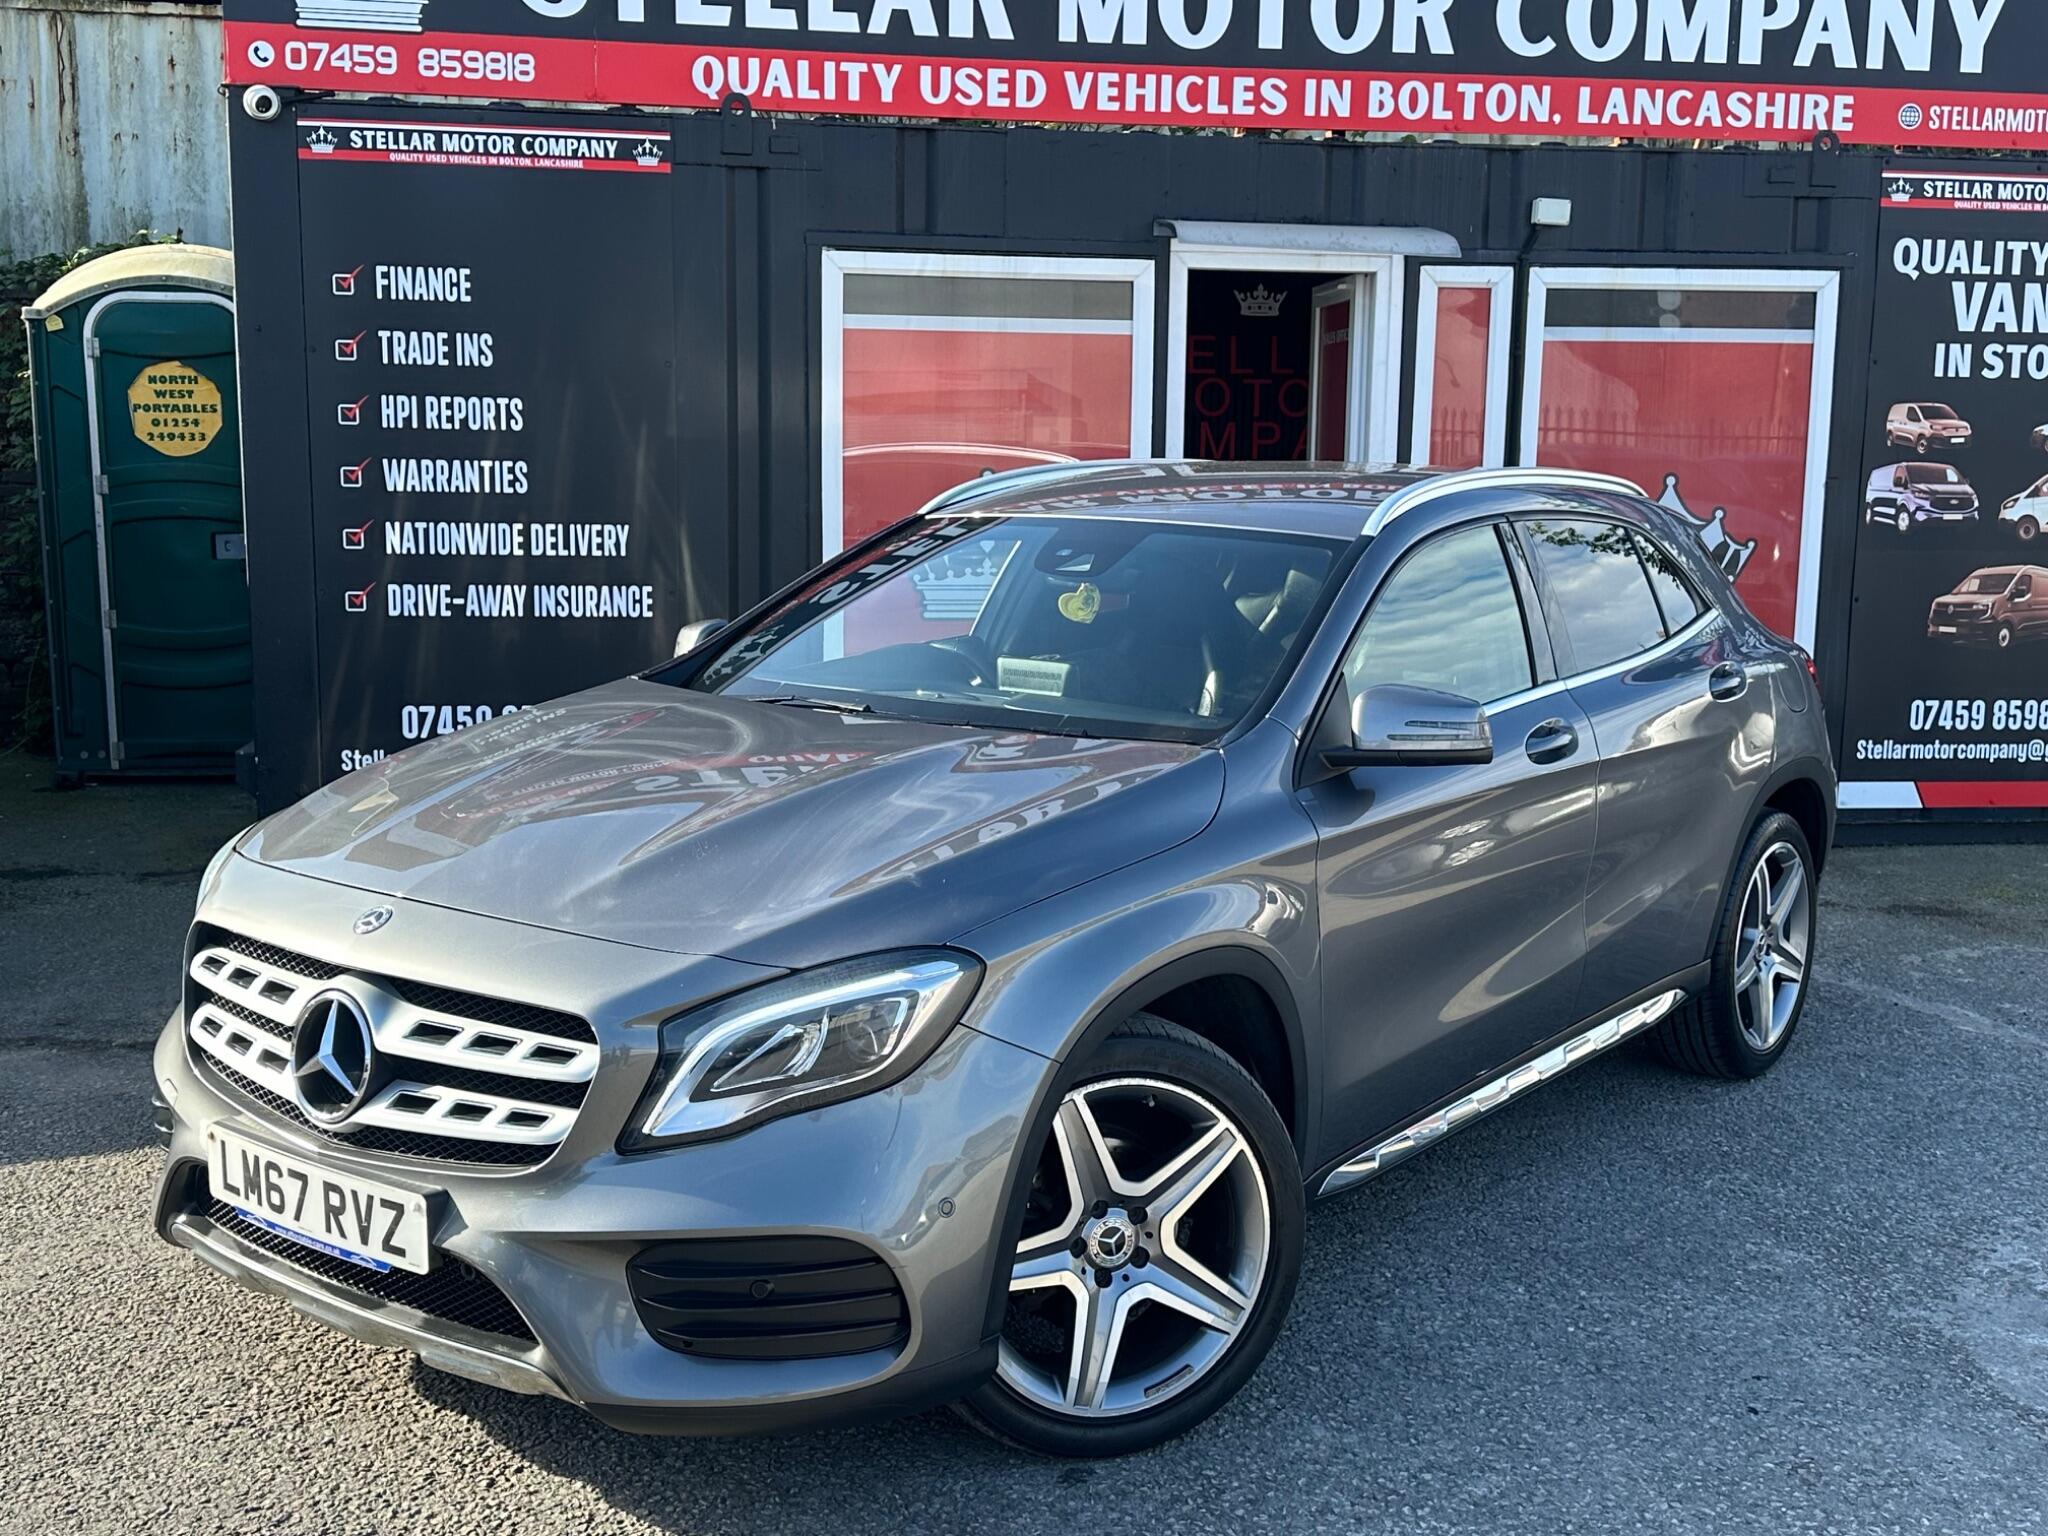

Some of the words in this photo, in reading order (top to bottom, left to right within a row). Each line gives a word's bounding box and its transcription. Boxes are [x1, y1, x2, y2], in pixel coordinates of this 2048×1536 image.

[1496, 0, 2005, 74] COMPANY
[285, 42, 397, 74] 07459
[417, 49, 535, 83] 859818
[692, 56, 902, 102] QUALITY
[920, 66, 1046, 108] USED
[1064, 71, 1287, 116] VEHICLES
[1304, 79, 1351, 117] IN
[1368, 81, 1561, 124] BOLTON,
[1578, 87, 1854, 132] LANCASHIRE
[1929, 105, 2048, 133] STELLARMOT
[350, 130, 436, 151] STELLAR
[442, 134, 514, 154] MOTOR
[520, 136, 617, 158] COMPANY
[389, 152, 424, 163] QUALITY
[425, 154, 447, 164] USED
[449, 155, 487, 166] VEHICLES
[488, 156, 497, 165] IN
[534, 158, 584, 169] LANCASHIRE
[1923, 181, 1992, 199] STELLAR
[1998, 183, 2048, 201] MOTO
[1953, 200, 1981, 209] QUALITY
[1983, 201, 2001, 210] USED
[2002, 202, 2032, 211] VEHICLES
[1893, 238, 2048, 280] QUALITY
[376, 266, 471, 302] FINANCE
[1951, 281, 2048, 333] VAN
[378, 331, 449, 366] TRADE
[456, 333, 493, 367] INS
[1934, 343, 1972, 378] IN
[1981, 343, 2048, 379] STO
[148, 375, 199, 385] NORTH
[153, 389, 194, 399] WEST
[133, 403, 218, 414] PORTABLES
[151, 418, 200, 428] 01254
[381, 395, 417, 429] HPI
[426, 396, 523, 431] REPORTS
[382, 458, 528, 493] WARRANTIES
[385, 522, 524, 555] NATIONWIDE
[531, 524, 629, 556] DELIVERY
[388, 584, 526, 617] DRIVE-AWAY
[534, 585, 653, 617] INSURANCE
[1910, 700, 1985, 730] 07459
[1992, 700, 2048, 730] 8598
[221, 1140, 308, 1222] LM67
[323, 1180, 406, 1258] RVZ
